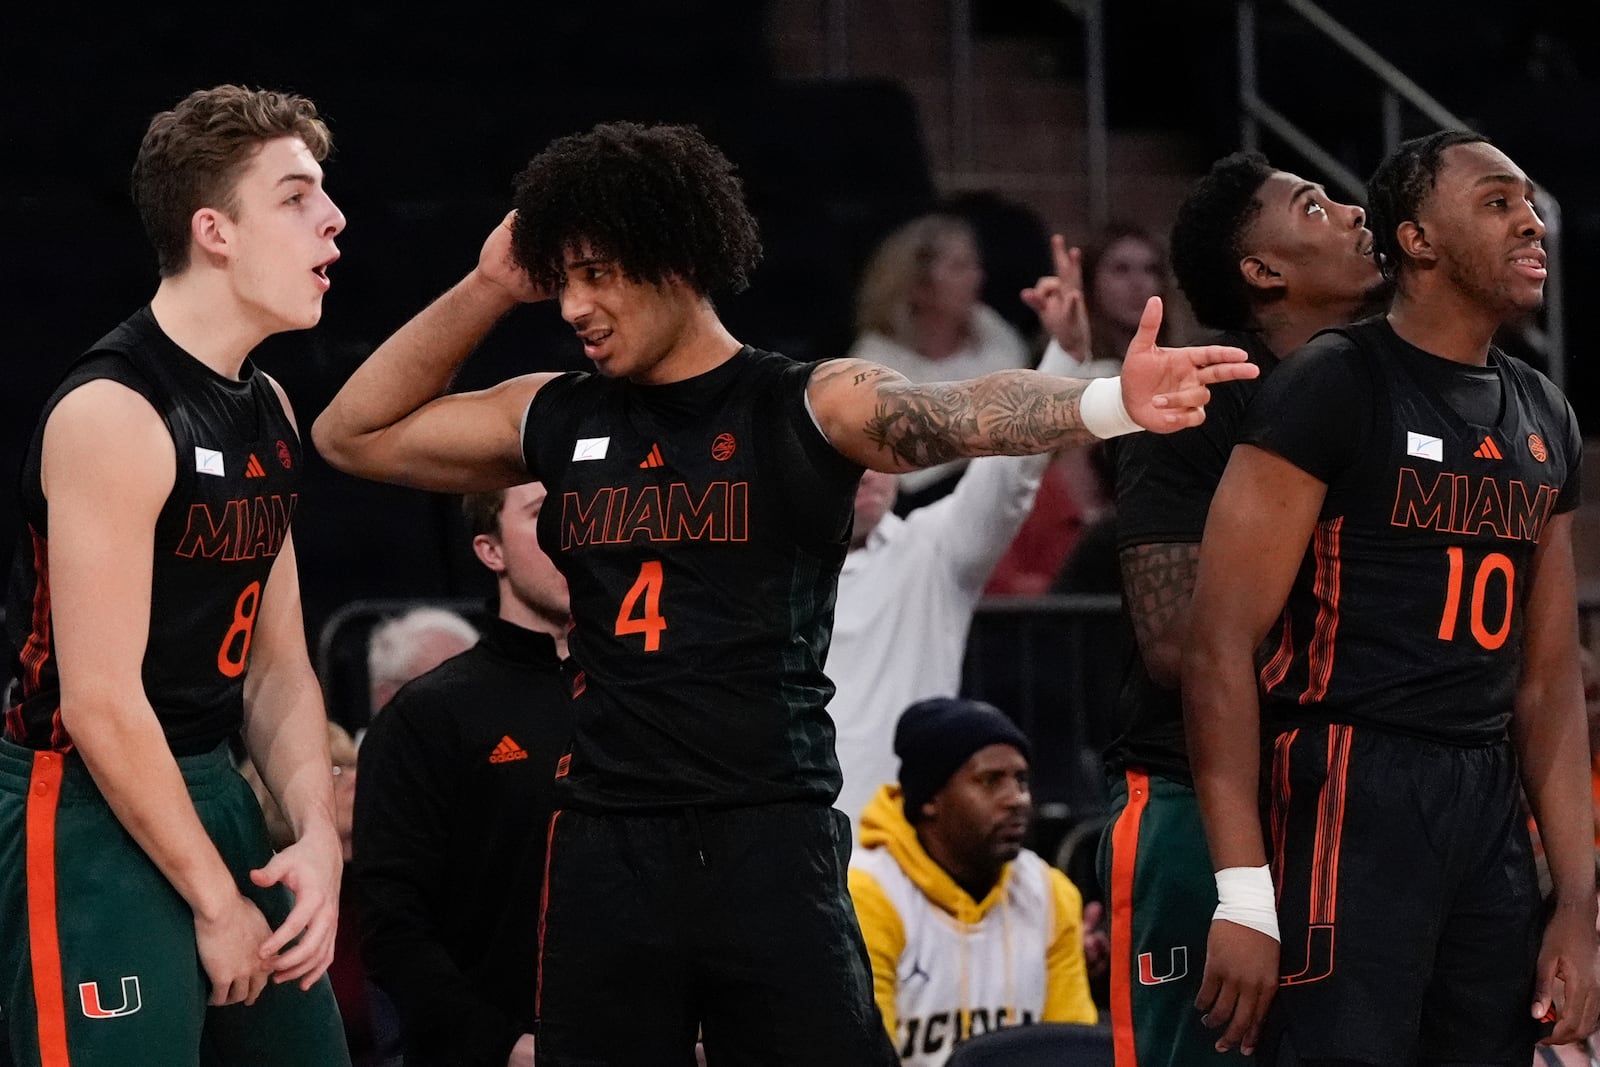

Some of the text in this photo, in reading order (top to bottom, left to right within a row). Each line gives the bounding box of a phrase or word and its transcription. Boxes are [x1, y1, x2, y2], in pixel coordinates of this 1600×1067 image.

[561, 481, 749, 551] MIAMI
[217, 580, 260, 678] 8
[614, 560, 668, 652] 4
[1437, 546, 1516, 651] 10
[489, 750, 528, 764] adidas
[78, 974, 142, 1020] U
[1137, 945, 1188, 986] U
